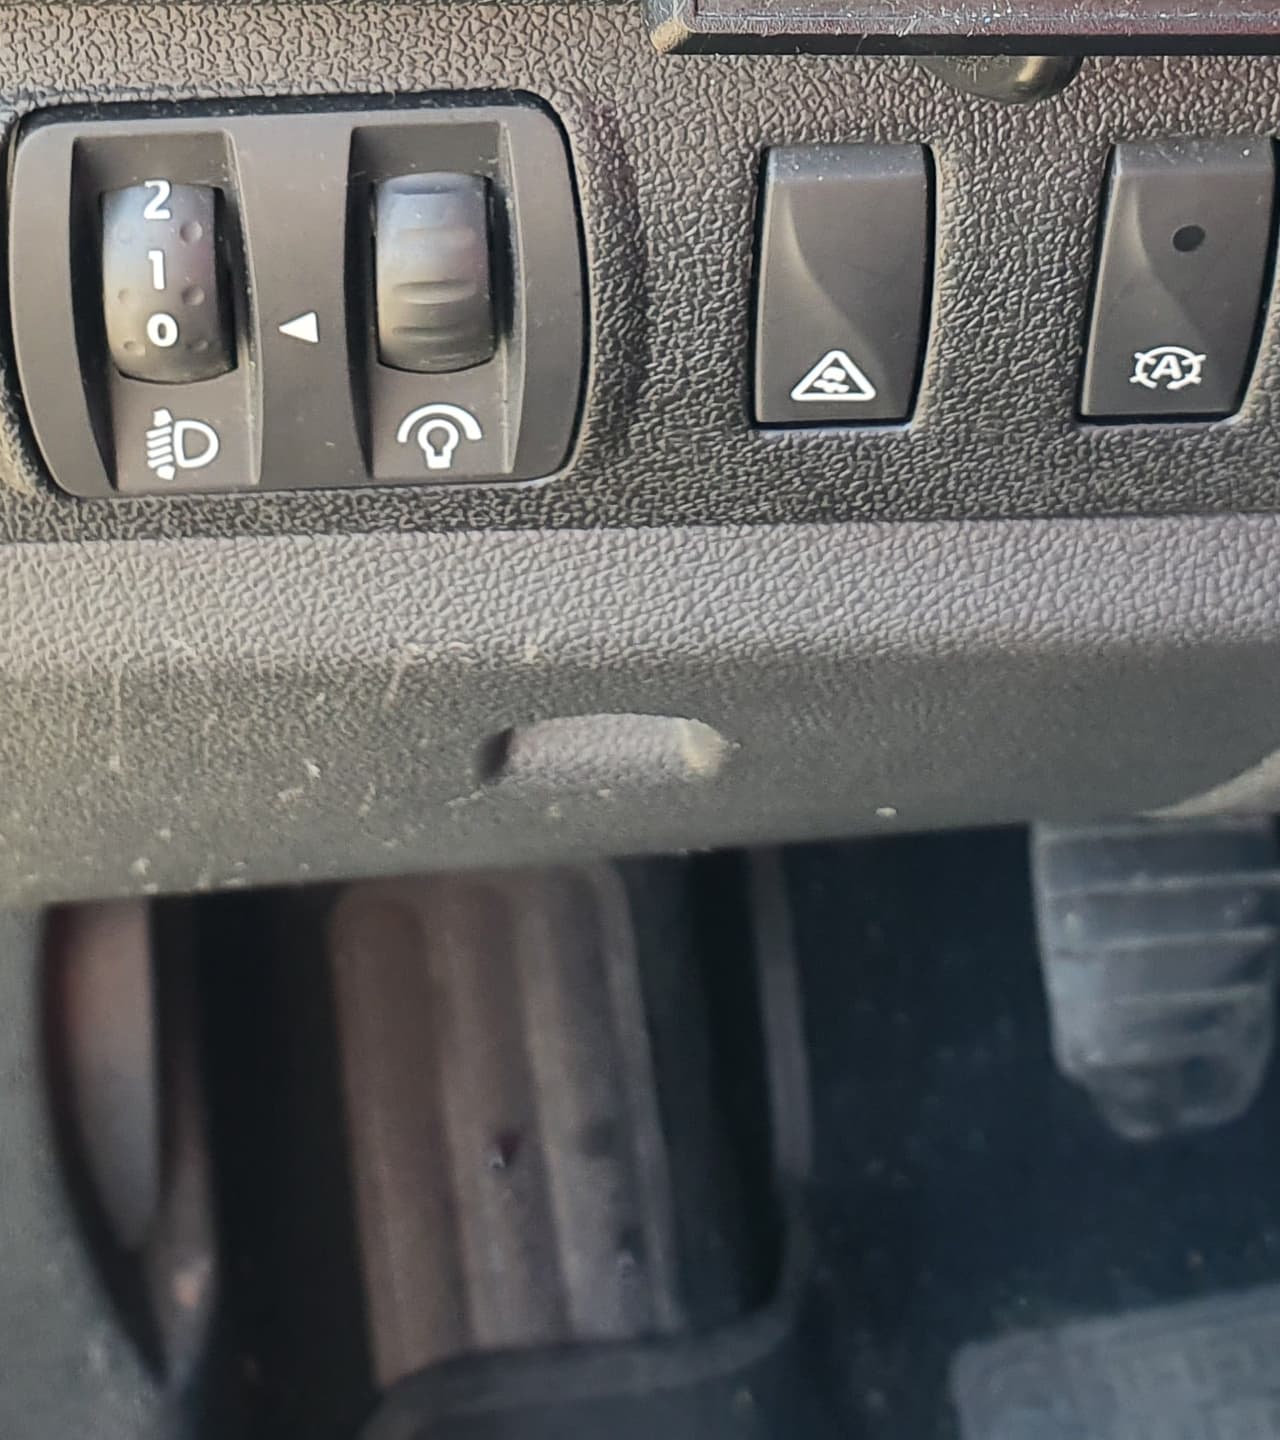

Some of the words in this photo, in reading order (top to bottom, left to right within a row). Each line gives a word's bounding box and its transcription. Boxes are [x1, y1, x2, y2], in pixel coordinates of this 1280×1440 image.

[143, 179, 172, 220] 2
[147, 249, 166, 290] 1
[147, 313, 178, 347] 0
